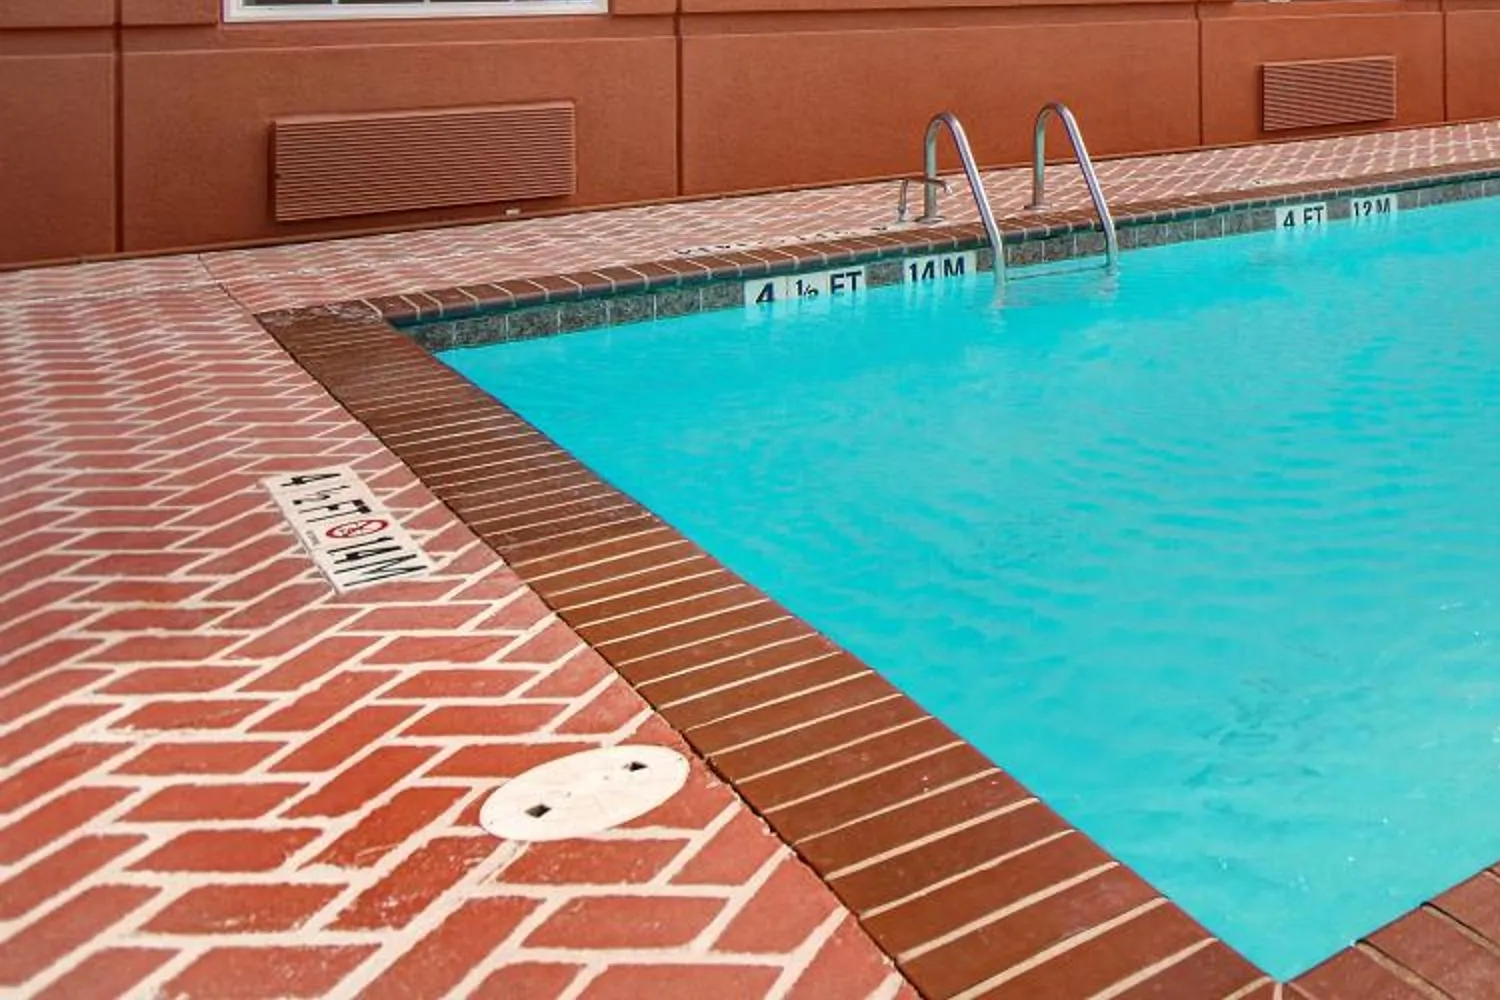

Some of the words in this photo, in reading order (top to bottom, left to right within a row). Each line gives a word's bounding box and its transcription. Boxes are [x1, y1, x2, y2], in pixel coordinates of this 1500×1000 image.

[1283, 210, 1295, 227] 4
[1303, 206, 1324, 225] FT
[755, 282, 776, 303] 4
[829, 271, 863, 296] FT
[280, 473, 342, 486] 4
[298, 499, 371, 522] FT
